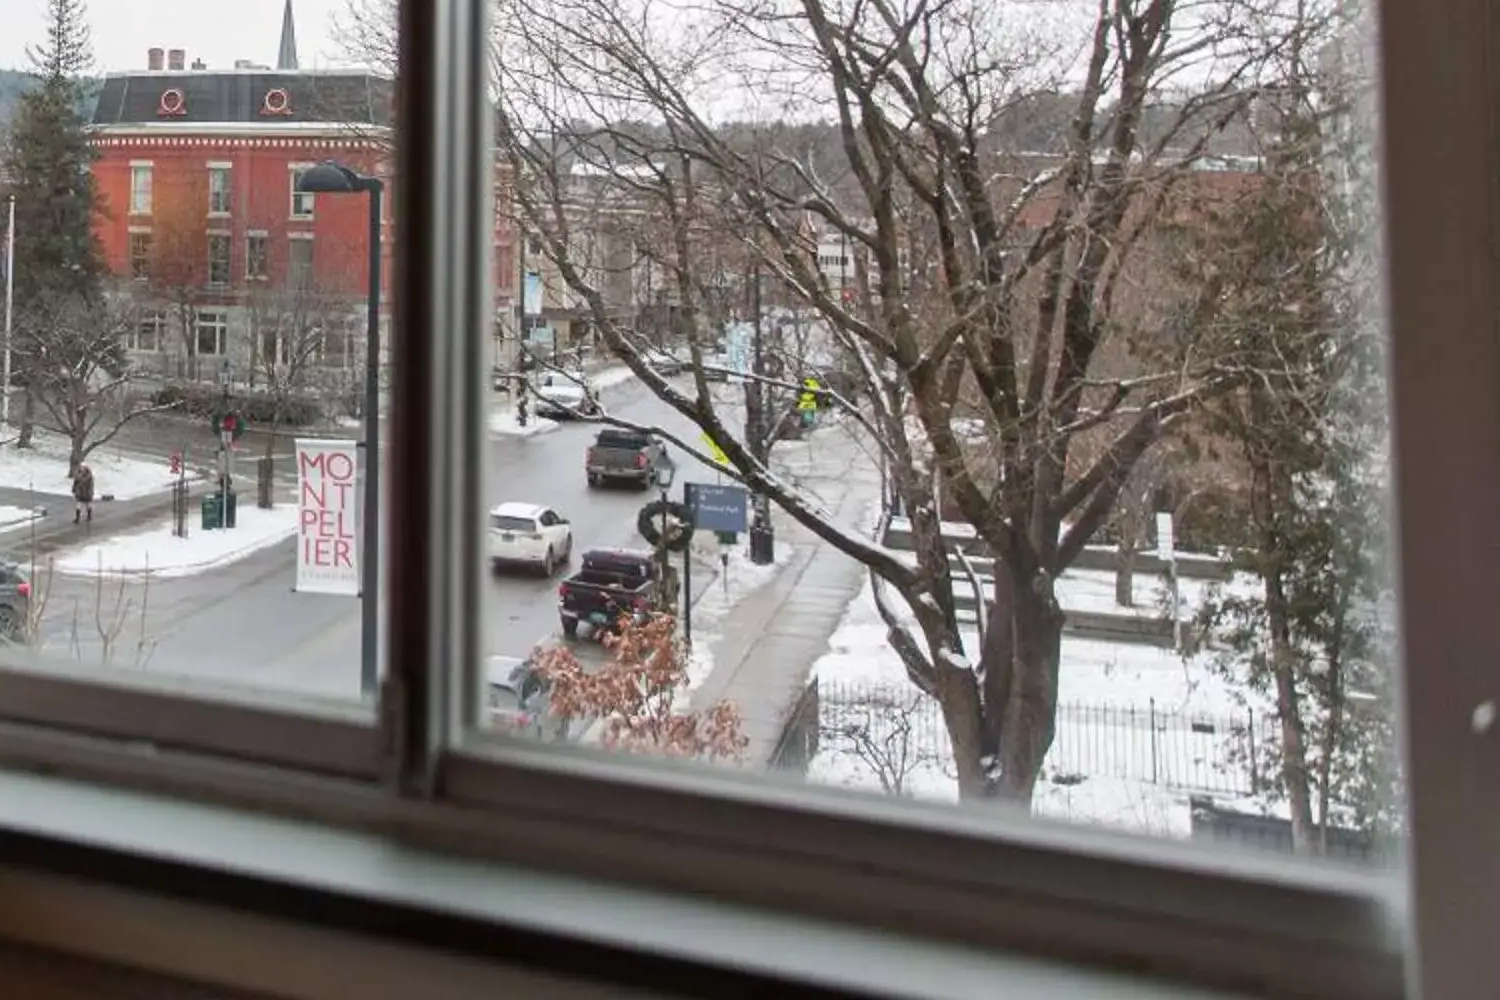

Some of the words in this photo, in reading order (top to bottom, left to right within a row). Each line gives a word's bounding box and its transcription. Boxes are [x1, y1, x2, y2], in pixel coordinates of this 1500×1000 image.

[300, 452, 353, 480] MO
[301, 509, 353, 539] PEL
[305, 539, 353, 568] IER
